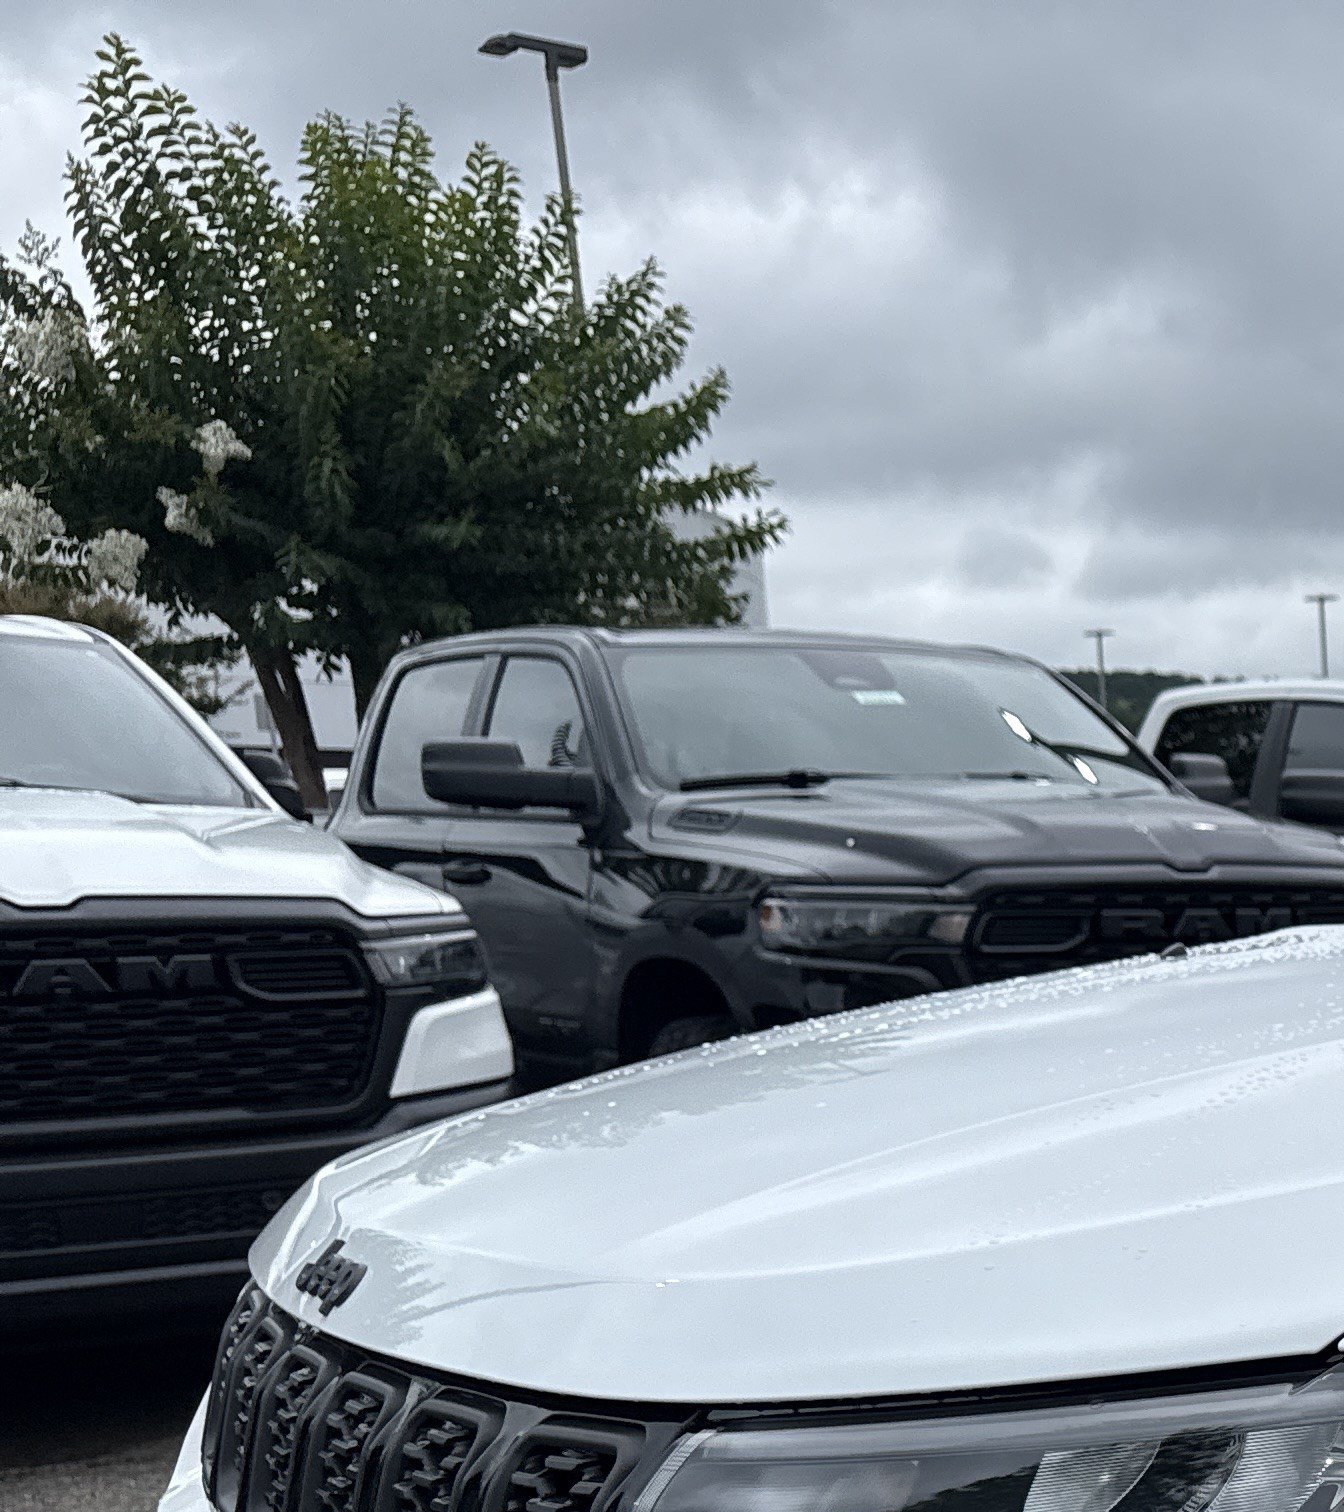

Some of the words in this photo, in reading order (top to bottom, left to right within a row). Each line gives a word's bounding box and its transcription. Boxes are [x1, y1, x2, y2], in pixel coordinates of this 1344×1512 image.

[1102, 907, 1292, 938] RAM
[0, 953, 214, 993] AM
[295, 1238, 368, 1317] Jeep
